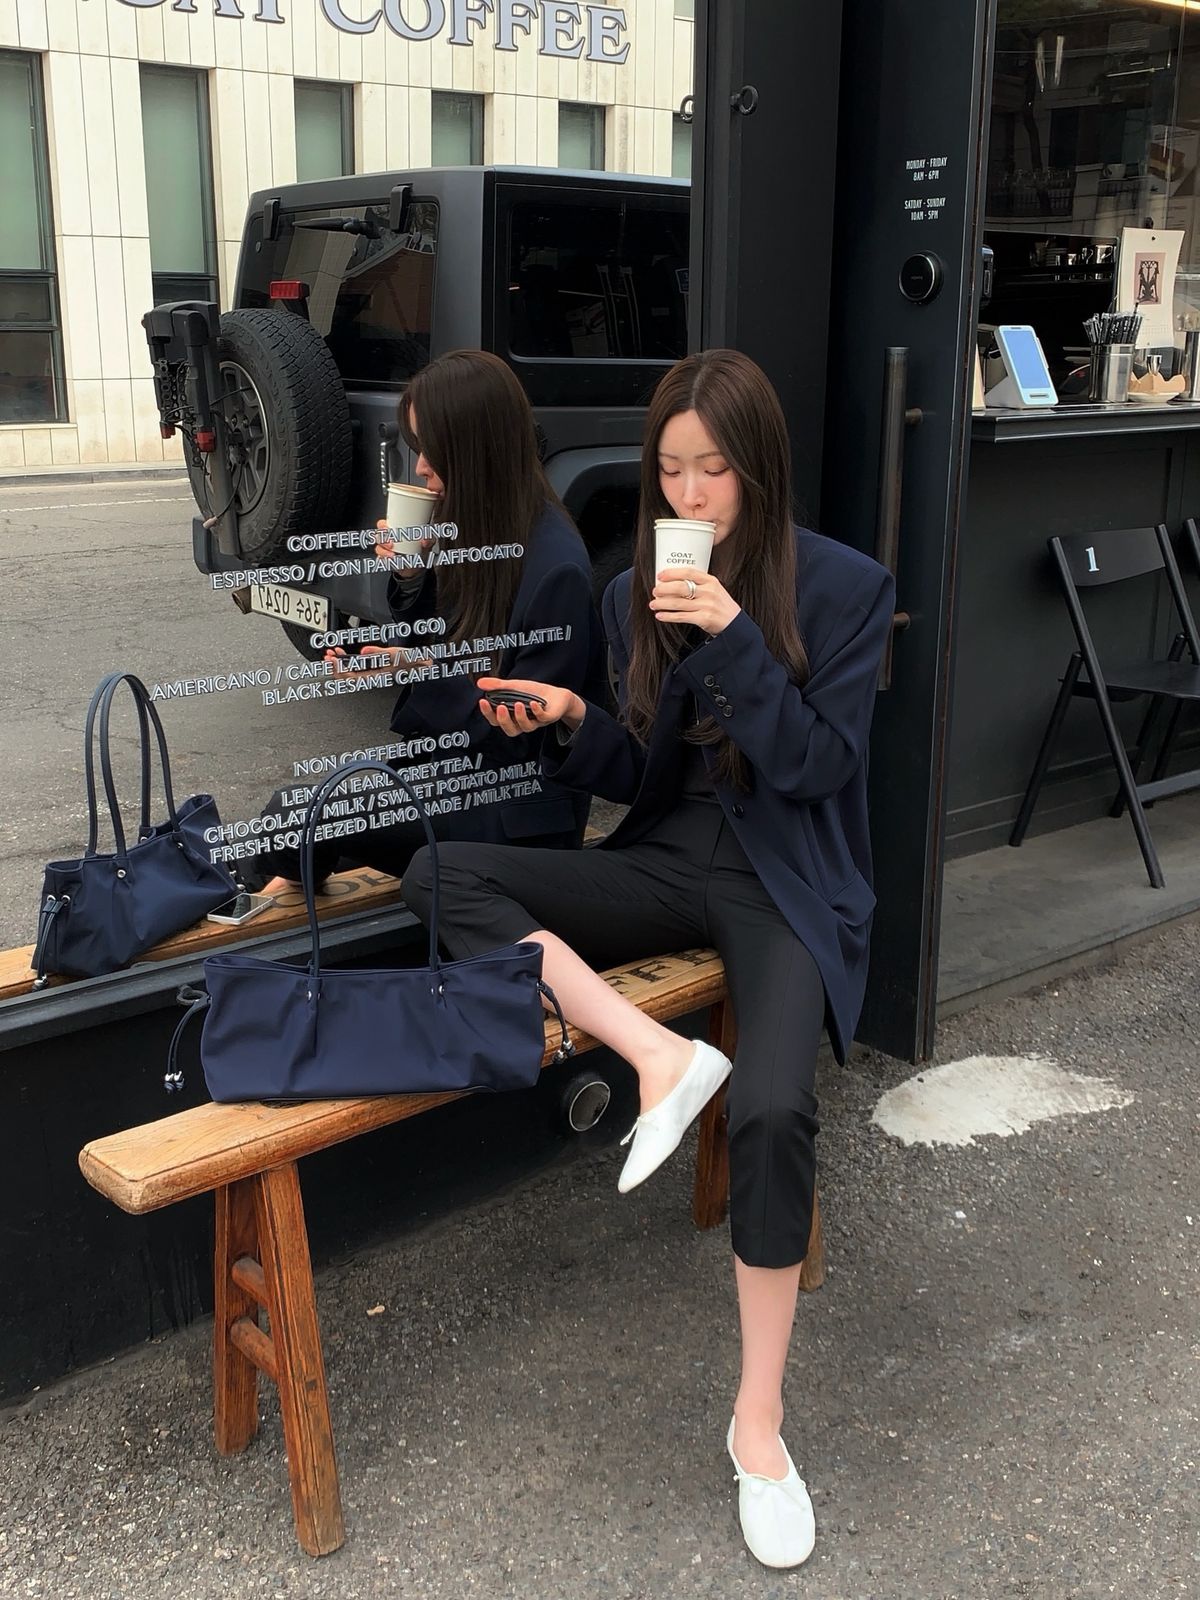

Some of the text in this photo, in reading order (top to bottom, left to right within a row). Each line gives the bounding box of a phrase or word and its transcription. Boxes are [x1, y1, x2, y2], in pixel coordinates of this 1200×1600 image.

[906, 159, 926, 170] MONDAY
[930, 156, 947, 168] FRIDAY
[928, 169, 939, 180] 6PM
[926, 197, 946, 208] SUNDAY
[928, 210, 938, 220] 5PM
[287, 522, 459, 552] COFFEE(STANDING)
[209, 542, 524, 590] ESPRESSO / CON PANNA / AFFOGATO
[1085, 546, 1100, 572] 1
[413, 617, 446, 635] GO)
[149, 624, 572, 701] AMERICANO / CAFE LATTE / VANILLA BEAN LATTE /
[262, 657, 492, 707] BLACK SESAME CAFE LATTE
[293, 754, 337, 777] NON
[438, 730, 470, 749] GO)
[350, 772, 394, 794] EARL
[397, 762, 440, 782] GREY
[441, 755, 474, 775] TEA
[475, 752, 483, 770] /
[203, 806, 316, 844] CHOCOLAT
[322, 796, 365, 819] MILK
[367, 793, 376, 812] /
[436, 770, 498, 795] POTATO
[500, 760, 537, 781] MILK
[209, 836, 270, 864] FRESH
[464, 792, 471, 811] /
[473, 784, 512, 807] MILK
[512, 778, 543, 797] TEA
